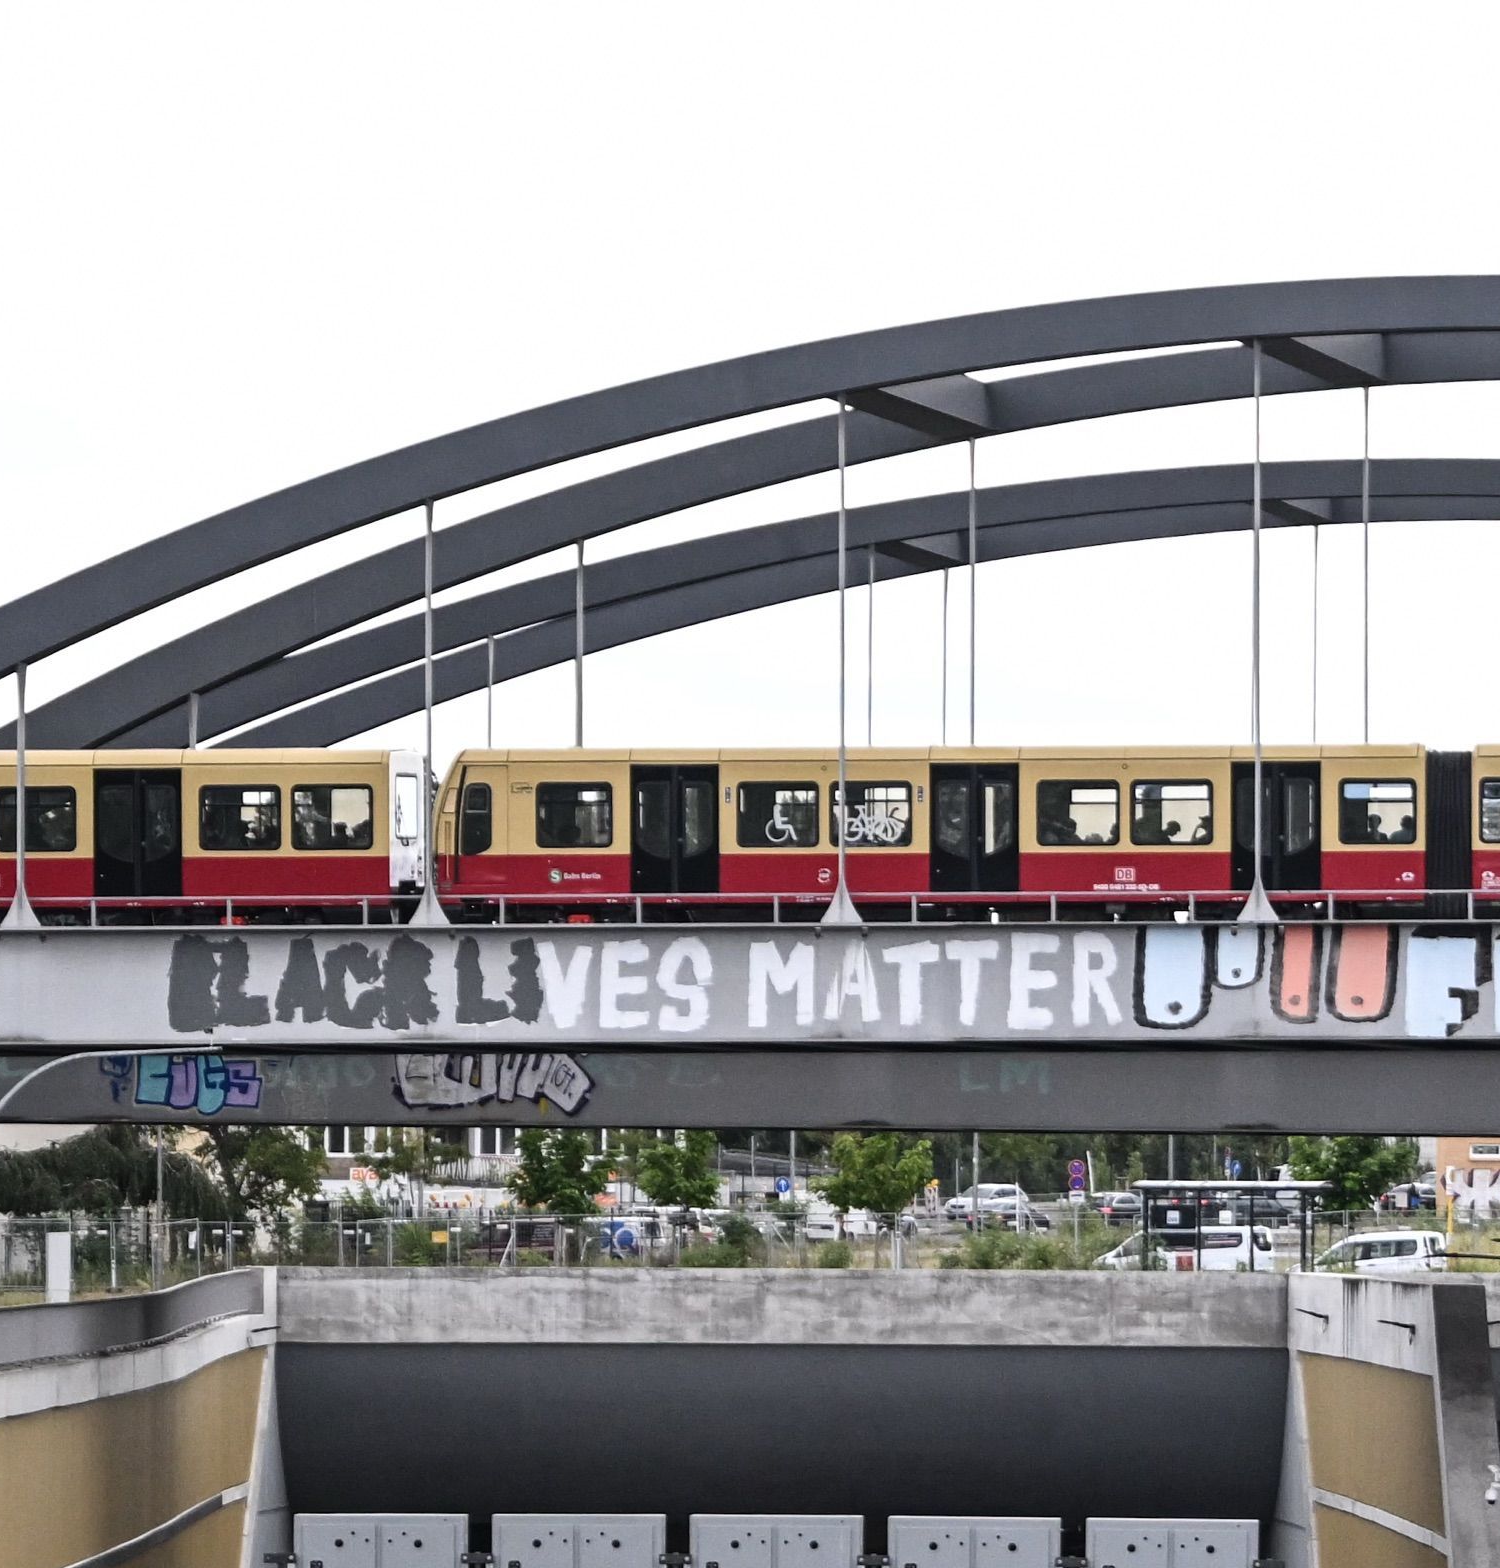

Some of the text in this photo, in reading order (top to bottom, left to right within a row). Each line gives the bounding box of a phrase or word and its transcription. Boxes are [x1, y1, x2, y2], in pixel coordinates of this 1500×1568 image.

[581, 872, 602, 880] Berlin
[1115, 868, 1134, 880] DB
[454, 935, 713, 1031] LIVES
[748, 931, 1122, 1030] MATTER
